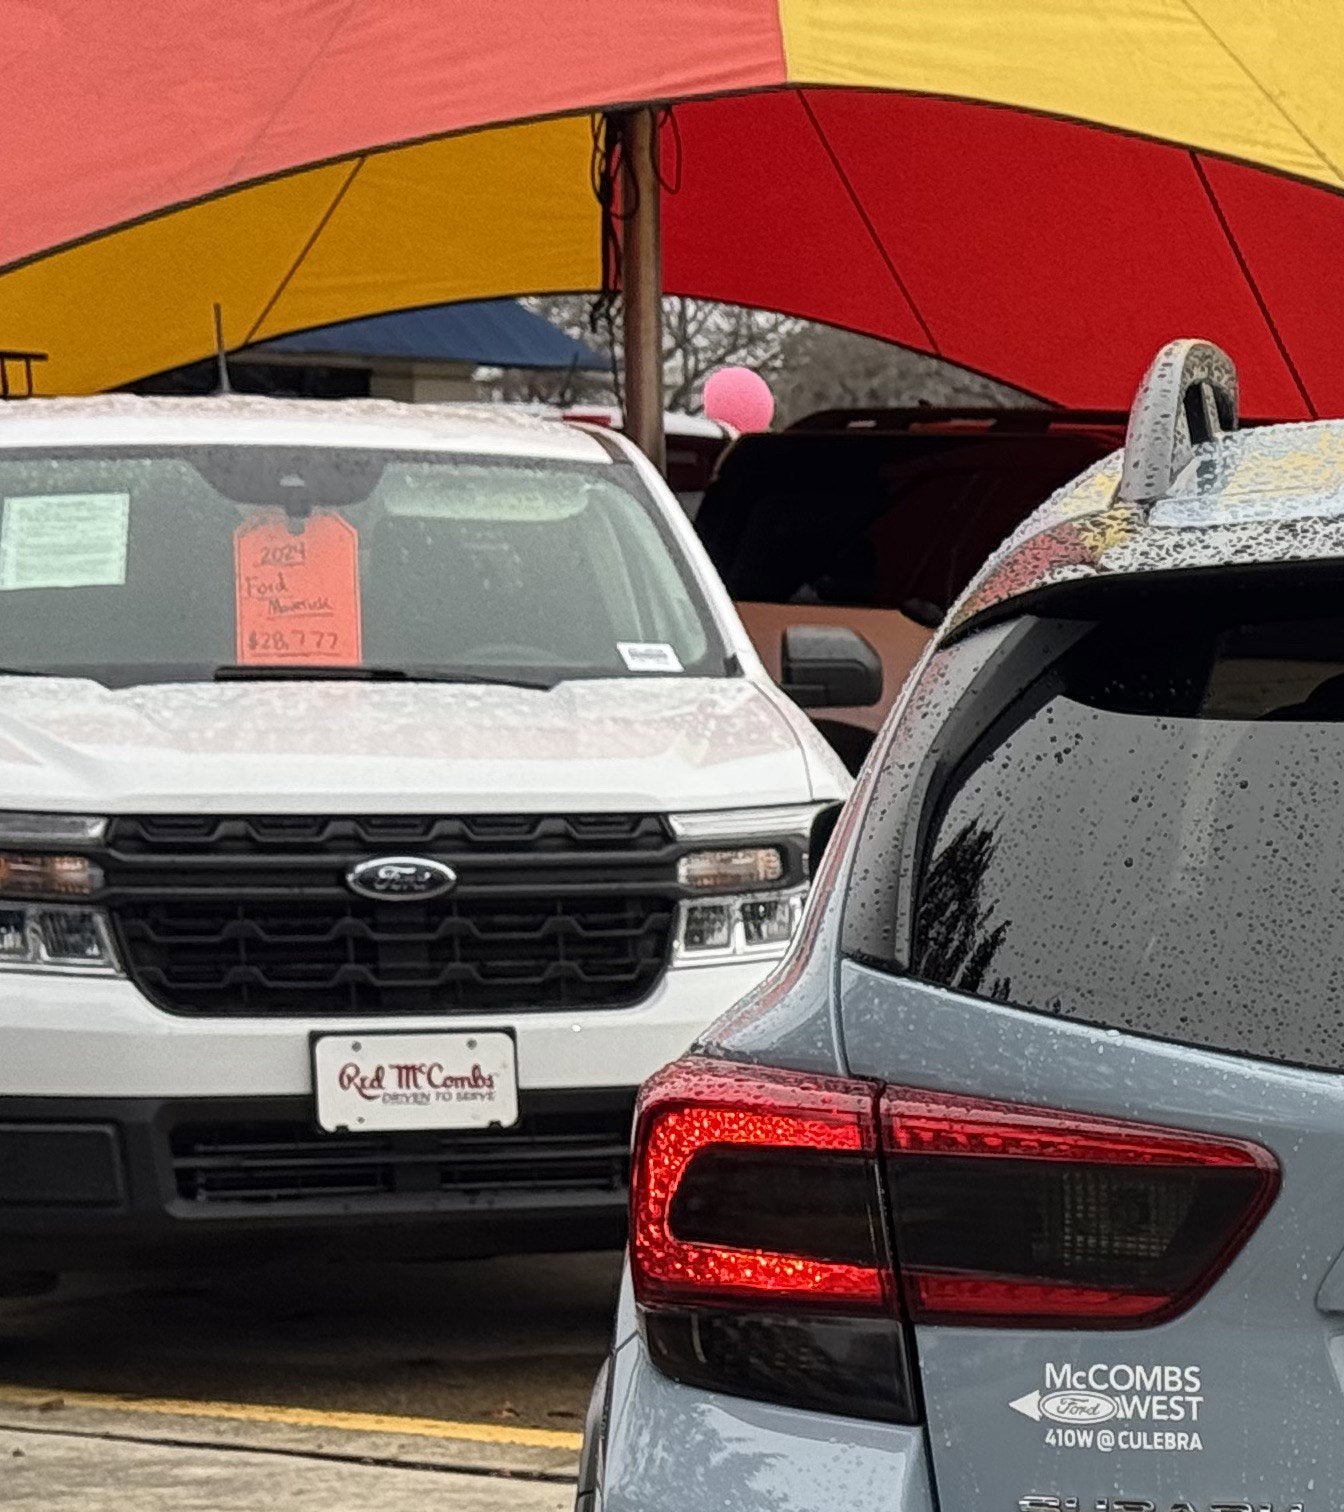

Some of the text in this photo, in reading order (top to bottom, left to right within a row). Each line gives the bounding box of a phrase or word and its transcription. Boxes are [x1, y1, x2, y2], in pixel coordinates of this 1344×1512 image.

[245, 572, 288, 597] Ford
[249, 630, 338, 651] $28,777
[338, 1062, 496, 1101] Red McCombs
[1045, 1363, 1201, 1393] McCOMBS
[1056, 1394, 1204, 1421] Ford WEST
[1045, 1429, 1094, 1448] 410W
[1118, 1431, 1204, 1450] CULEBRA
